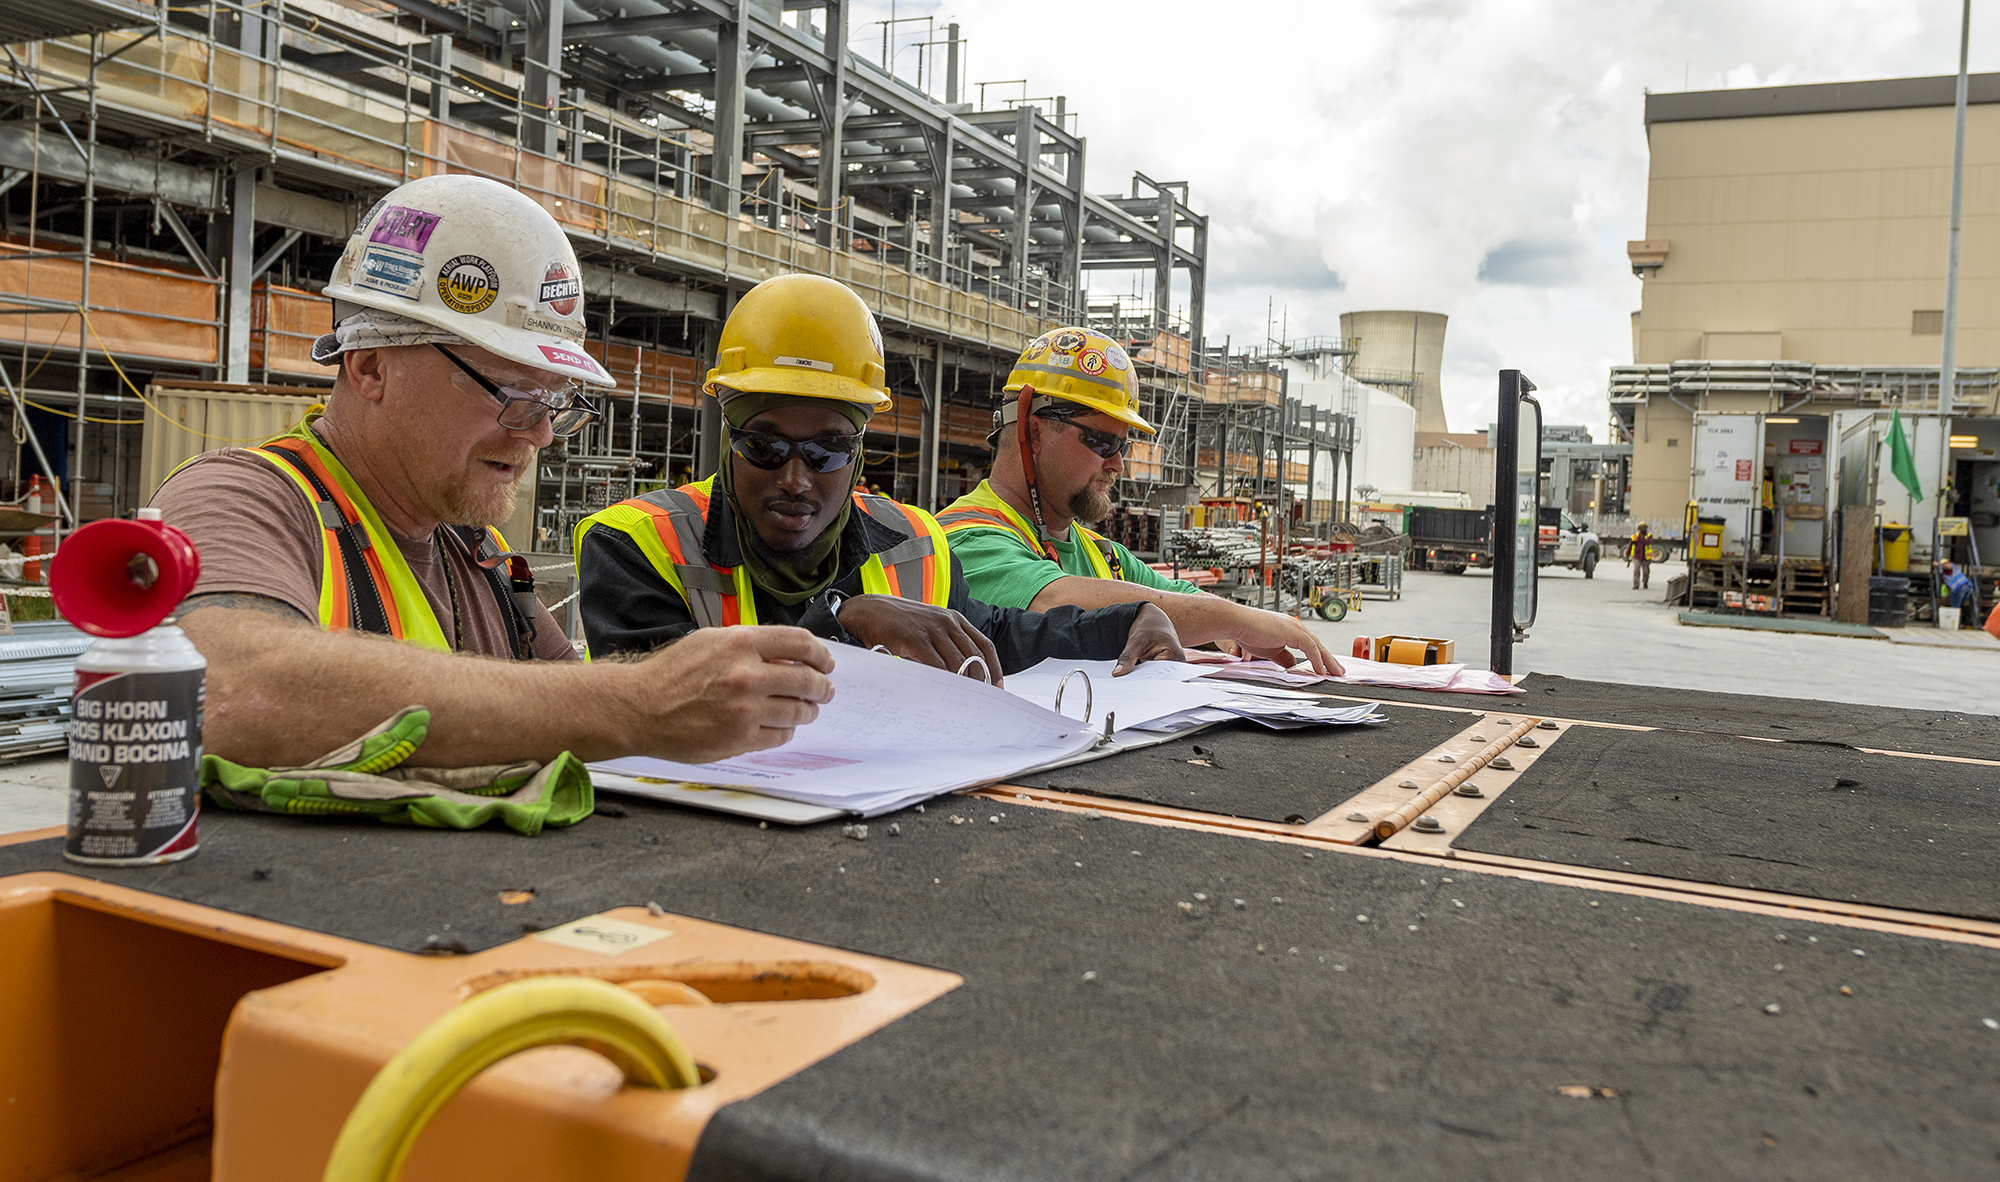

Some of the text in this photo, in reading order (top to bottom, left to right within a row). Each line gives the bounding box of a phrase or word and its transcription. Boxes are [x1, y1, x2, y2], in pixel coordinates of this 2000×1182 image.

[441, 255, 499, 288] AERIAL WORK PLATFORM
[384, 282, 407, 292] PROGRAM
[450, 272, 487, 294] AWP
[439, 281, 495, 312] OPERATOR/SPOTTER
[527, 317, 562, 333] SHANNON
[552, 351, 592, 368] SEND IT
[77, 699, 168, 720] BIG HORN
[103, 720, 188, 742] KLAXON
[114, 740, 190, 764] BOCINA
